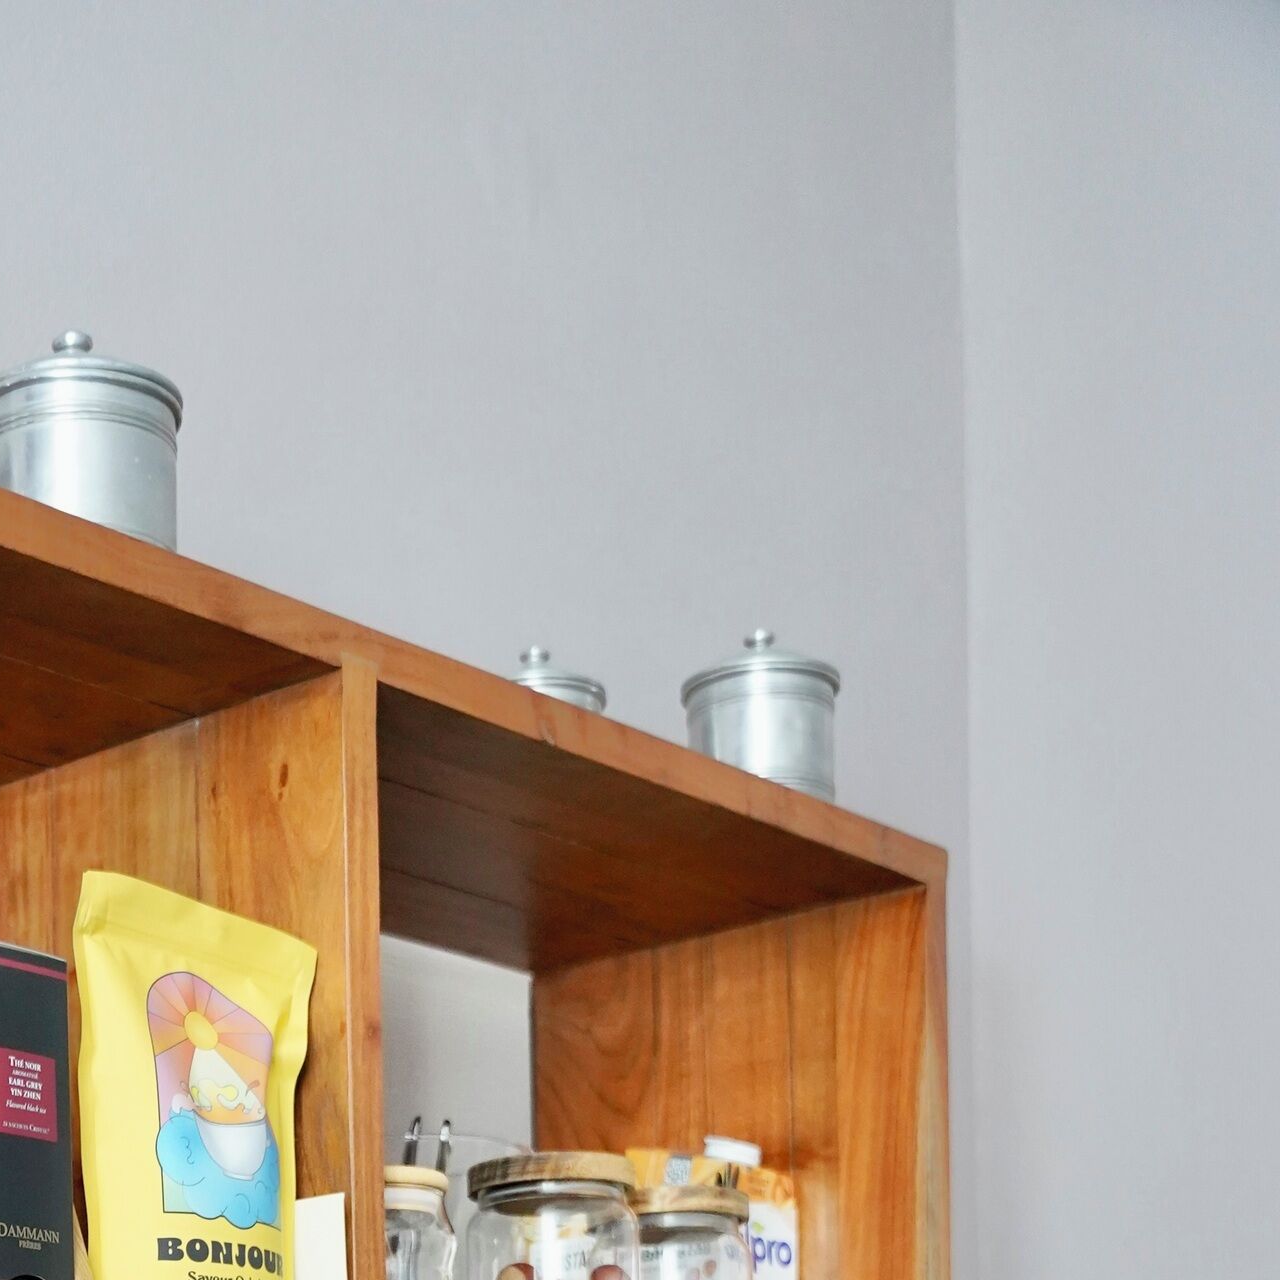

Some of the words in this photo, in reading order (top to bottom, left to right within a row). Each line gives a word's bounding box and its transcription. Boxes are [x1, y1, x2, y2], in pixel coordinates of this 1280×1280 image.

[25, 1061, 42, 1073] NOIR
[8, 1077, 25, 1088] EARL
[25, 1081, 43, 1091] GREY
[157, 1237, 283, 1277] BONJOUR
